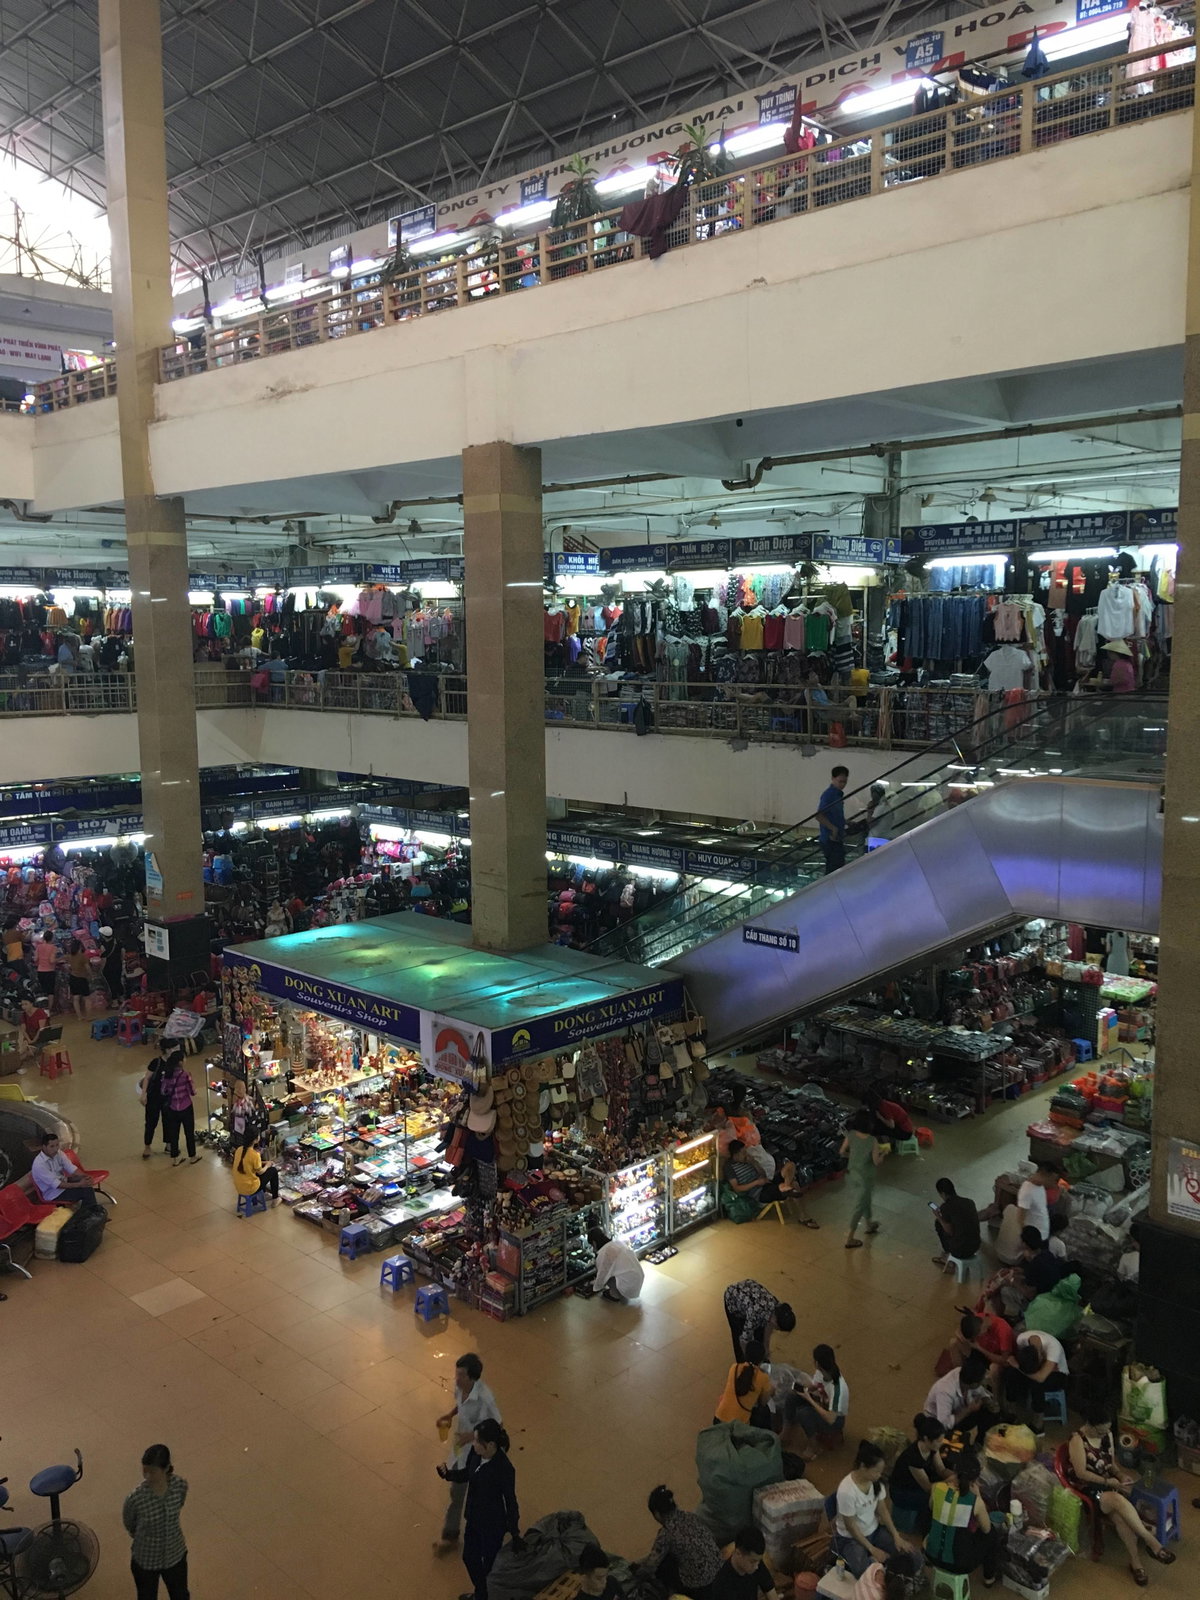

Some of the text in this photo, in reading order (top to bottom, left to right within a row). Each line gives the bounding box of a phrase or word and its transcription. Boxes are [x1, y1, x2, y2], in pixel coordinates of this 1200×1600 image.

[915, 44, 935, 59] A5
[485, 183, 510, 200] TY
[692, 100, 744, 128] MẠI
[805, 52, 881, 88] DỊCH
[760, 110, 772, 124] A5
[948, 522, 1014, 537] THÌN
[697, 853, 712, 864] HUY
[758, 932, 778, 945] THANG
[284, 975, 402, 1022] DONG XUAN ART
[296, 990, 389, 1027] Souvenirs Shop
[553, 989, 666, 1034] DONG XUAN ART
[566, 1005, 655, 1040] Souvenirs Shop
